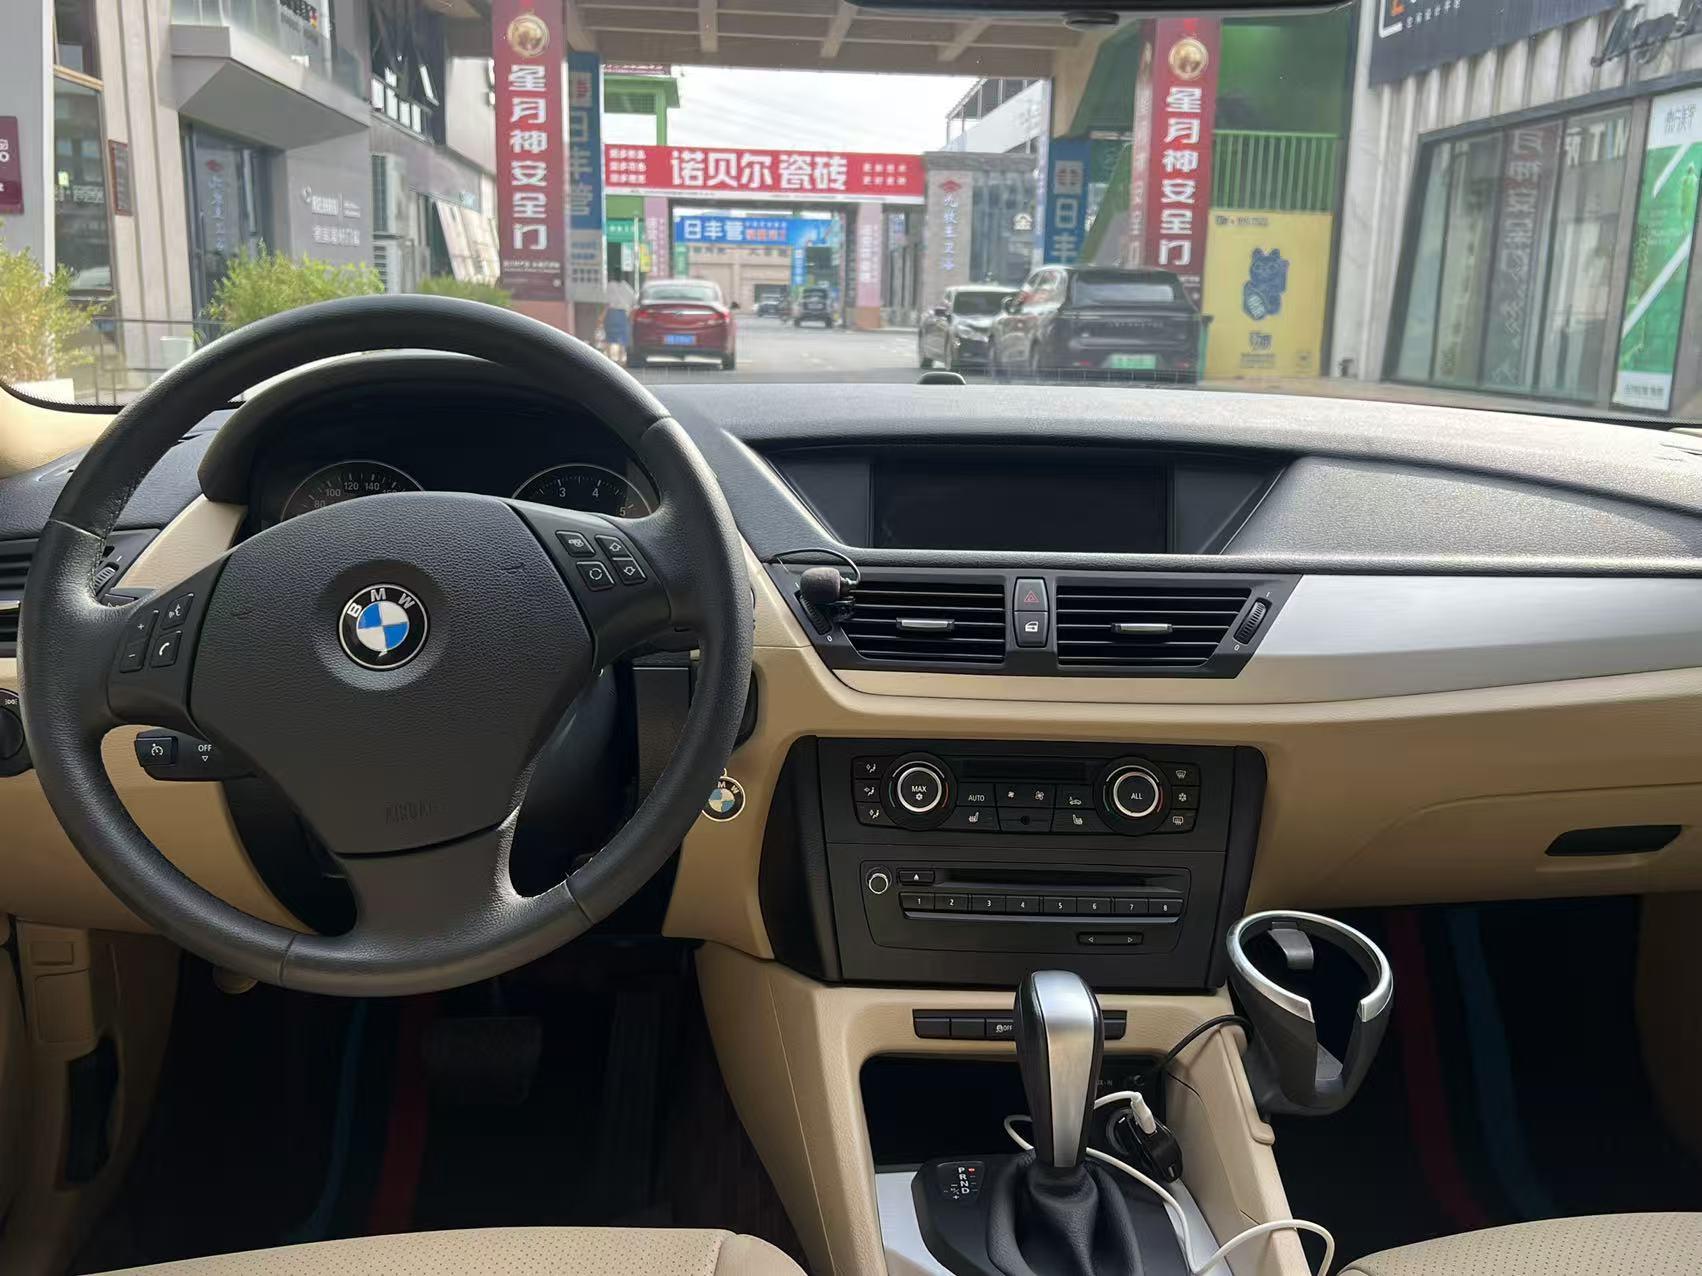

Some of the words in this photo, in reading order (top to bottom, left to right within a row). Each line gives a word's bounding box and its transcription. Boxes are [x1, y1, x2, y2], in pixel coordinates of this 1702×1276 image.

[508, 64, 548, 250] 星月神安全门
[671, 150, 848, 190] 诺贝尔瓷砖
[1158, 86, 1203, 266] 星月神安全门
[684, 219, 744, 241] 日丰管
[344, 482, 359, 491] 120
[365, 482, 380, 491] 140
[326, 488, 341, 497] 100
[559, 487, 566, 498] 3
[591, 487, 600, 498] 4
[313, 499, 326, 508] 80
[619, 506, 626, 516] 5
[346, 587, 416, 619] BMW
[198, 744, 212, 752] OFF
[911, 785, 927, 793] MAX
[968, 794, 985, 802] AUTO
[1130, 792, 1143, 800] ALL
[1163, 904, 1168, 912] 8
